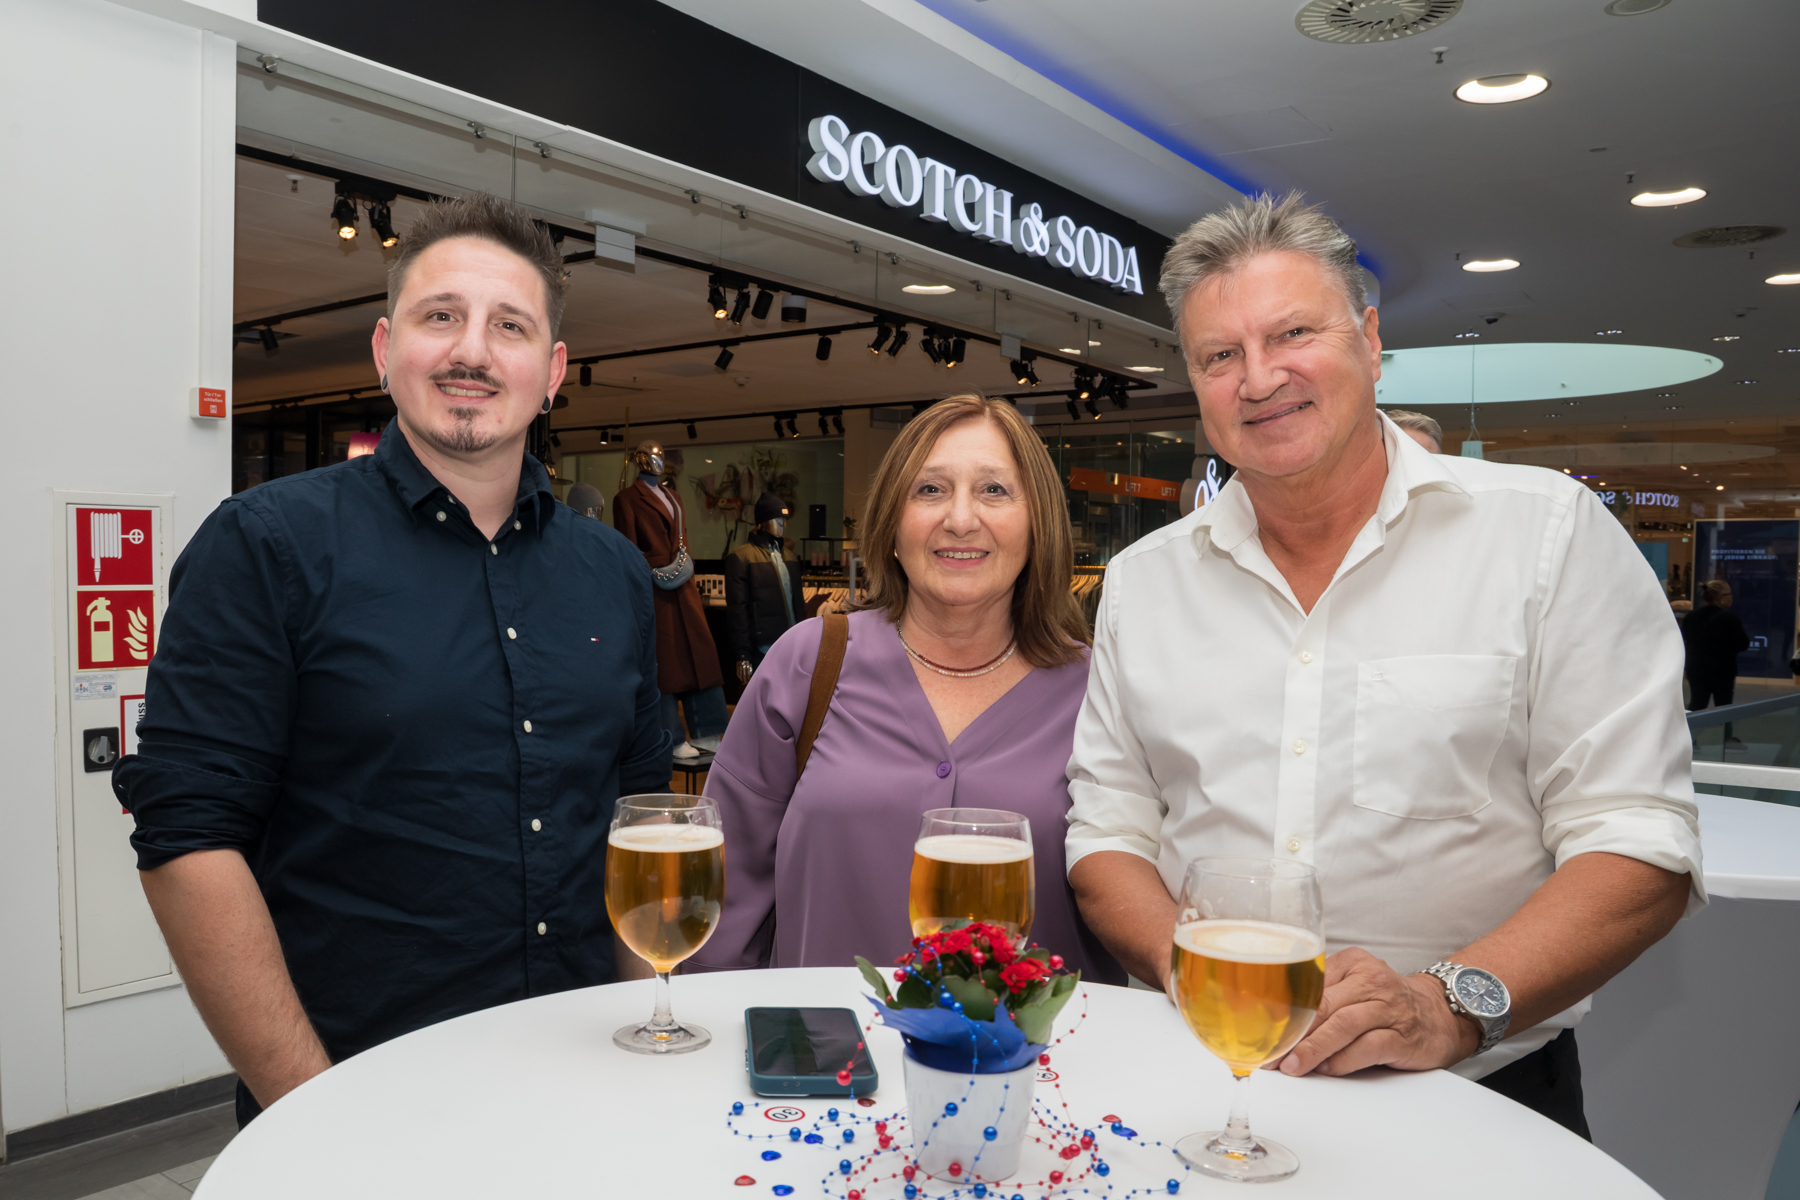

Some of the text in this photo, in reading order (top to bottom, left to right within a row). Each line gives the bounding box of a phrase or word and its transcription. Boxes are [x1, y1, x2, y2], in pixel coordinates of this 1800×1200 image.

[806, 115, 1144, 295] SCOTCH & SODA
[1125, 482, 1137, 493] LFT
